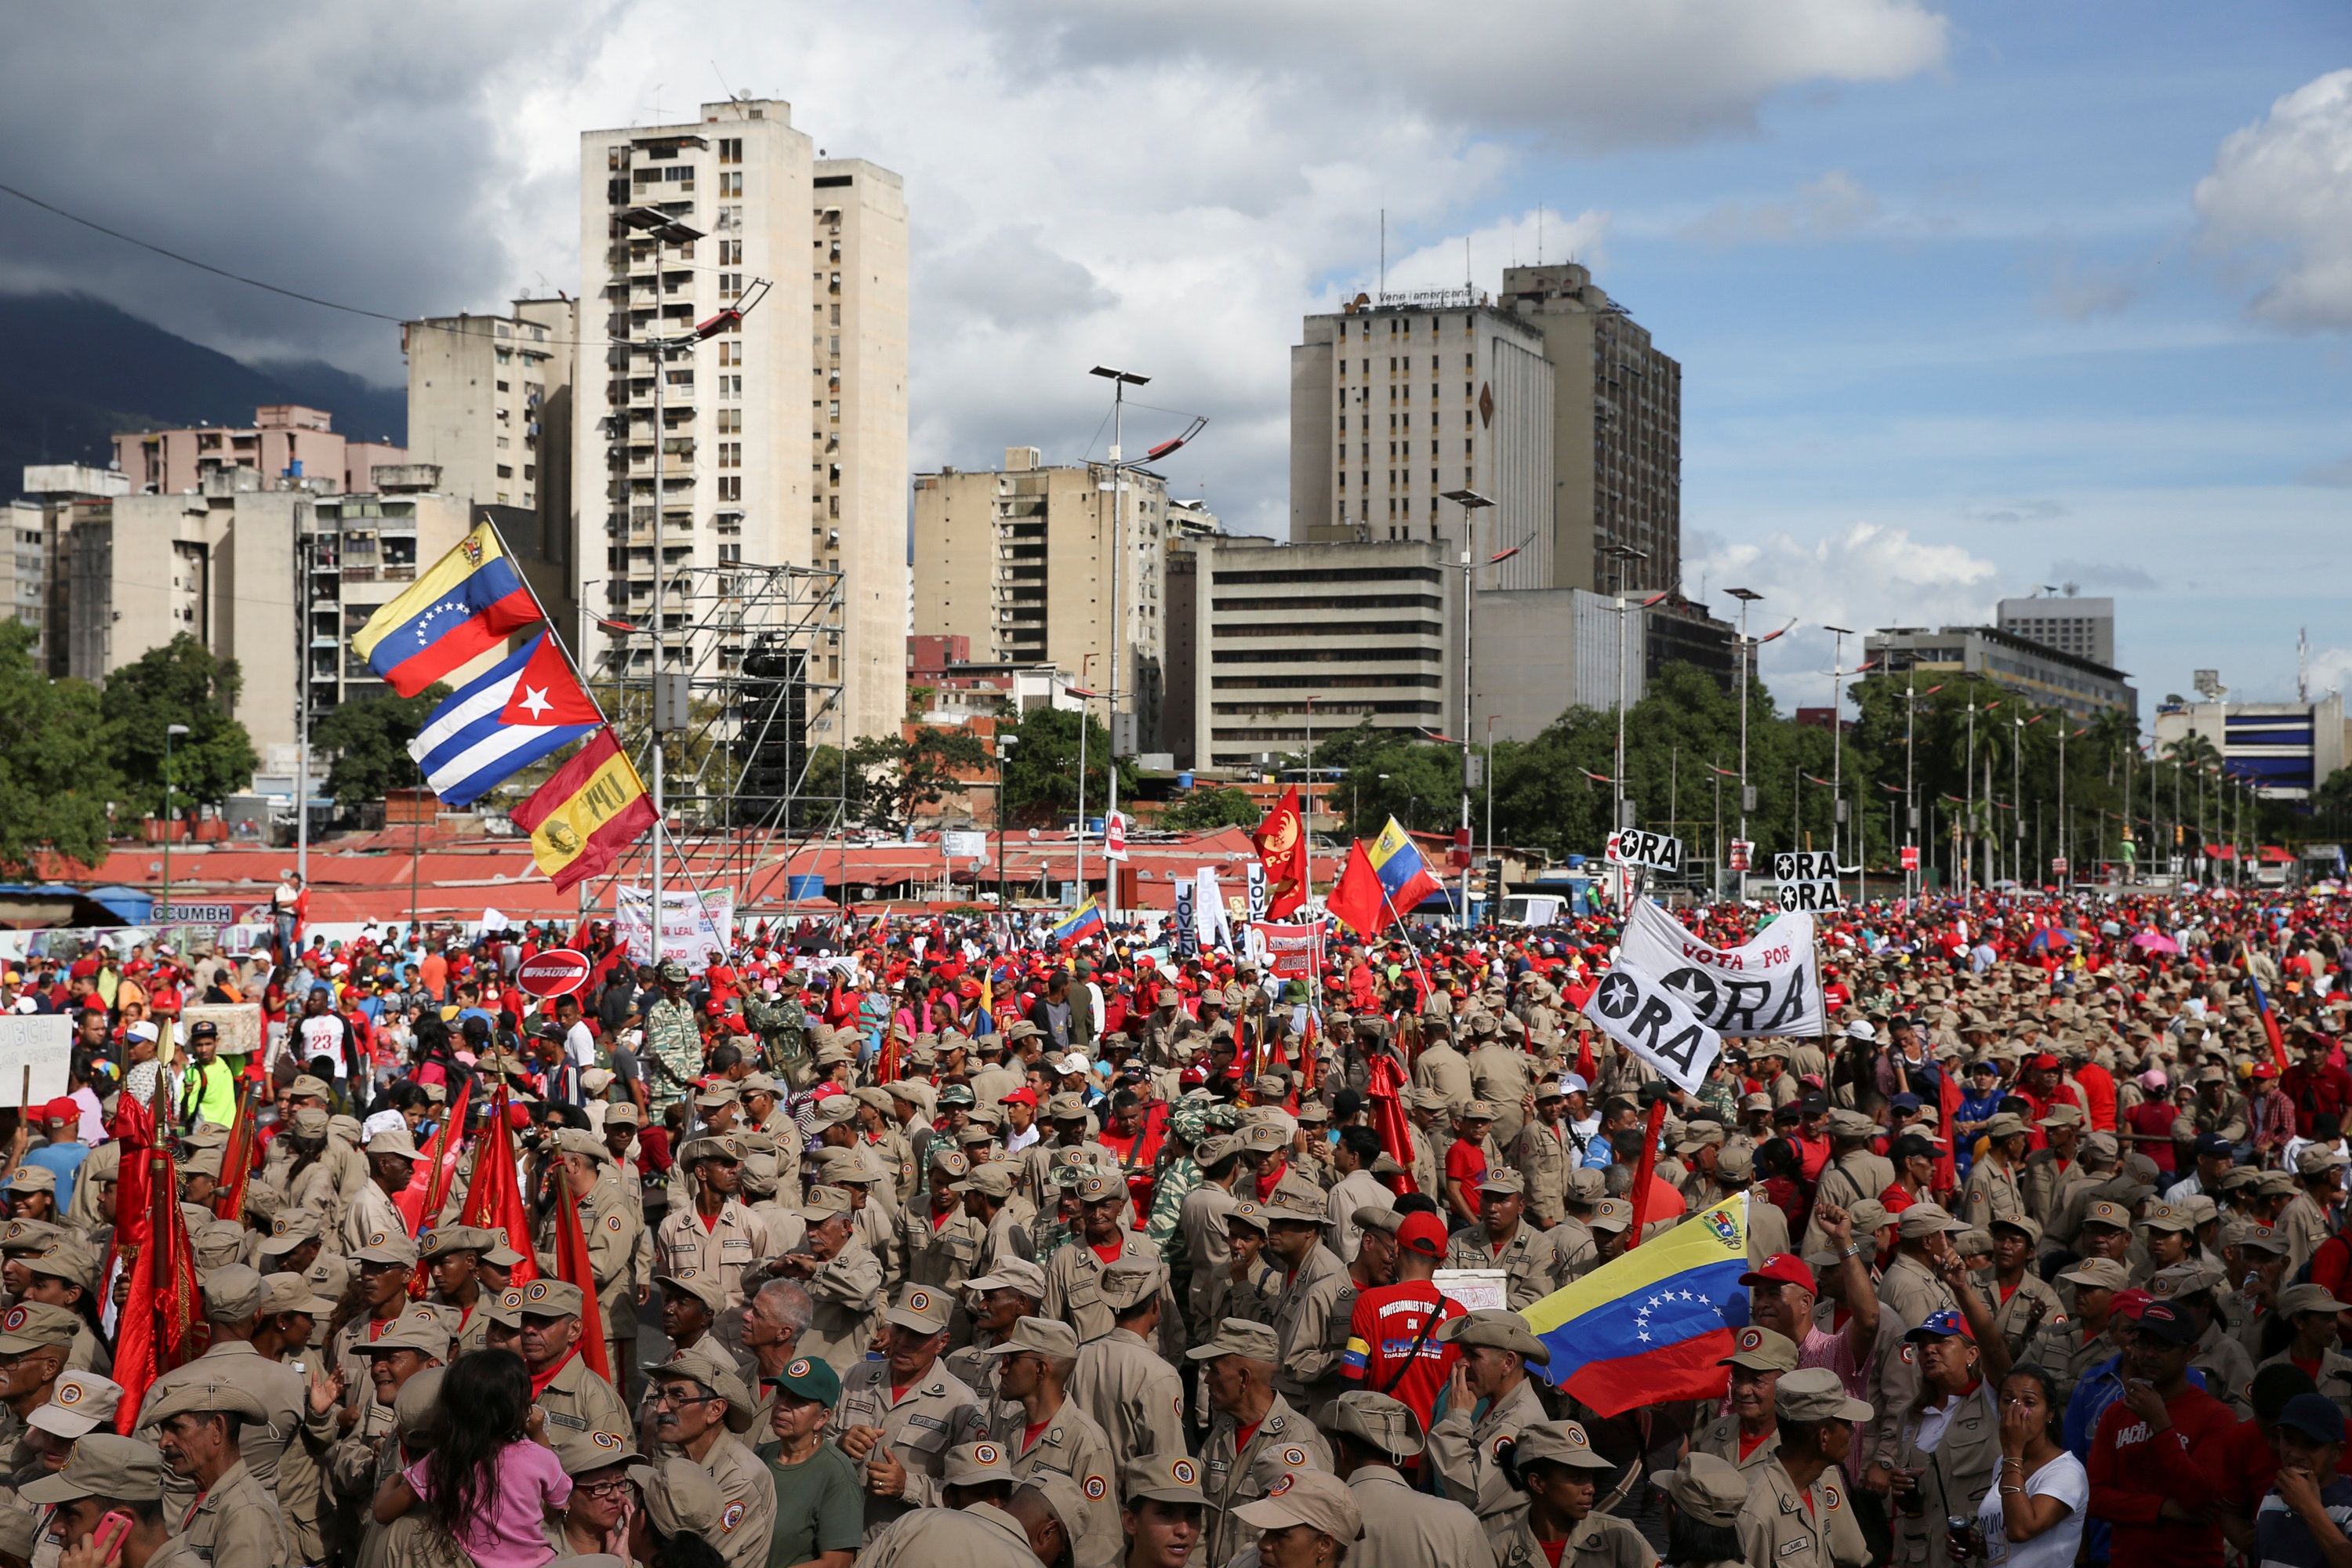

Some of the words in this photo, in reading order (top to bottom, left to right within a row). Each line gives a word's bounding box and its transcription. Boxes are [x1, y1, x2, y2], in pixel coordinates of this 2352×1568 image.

[1619, 829, 1676, 868] ORA
[1776, 852, 1838, 881] ORA
[1780, 882, 1838, 912] ORA
[1178, 884, 1196, 956] JOVEN
[1682, 943, 1744, 970] VOTA
[1764, 945, 1791, 968] POR
[1660, 964, 1804, 1030] ORA
[1598, 972, 1704, 1077] ORA
[313, 1035, 332, 1050] 23
[1379, 1300, 1420, 1319] PROFESIONALES
